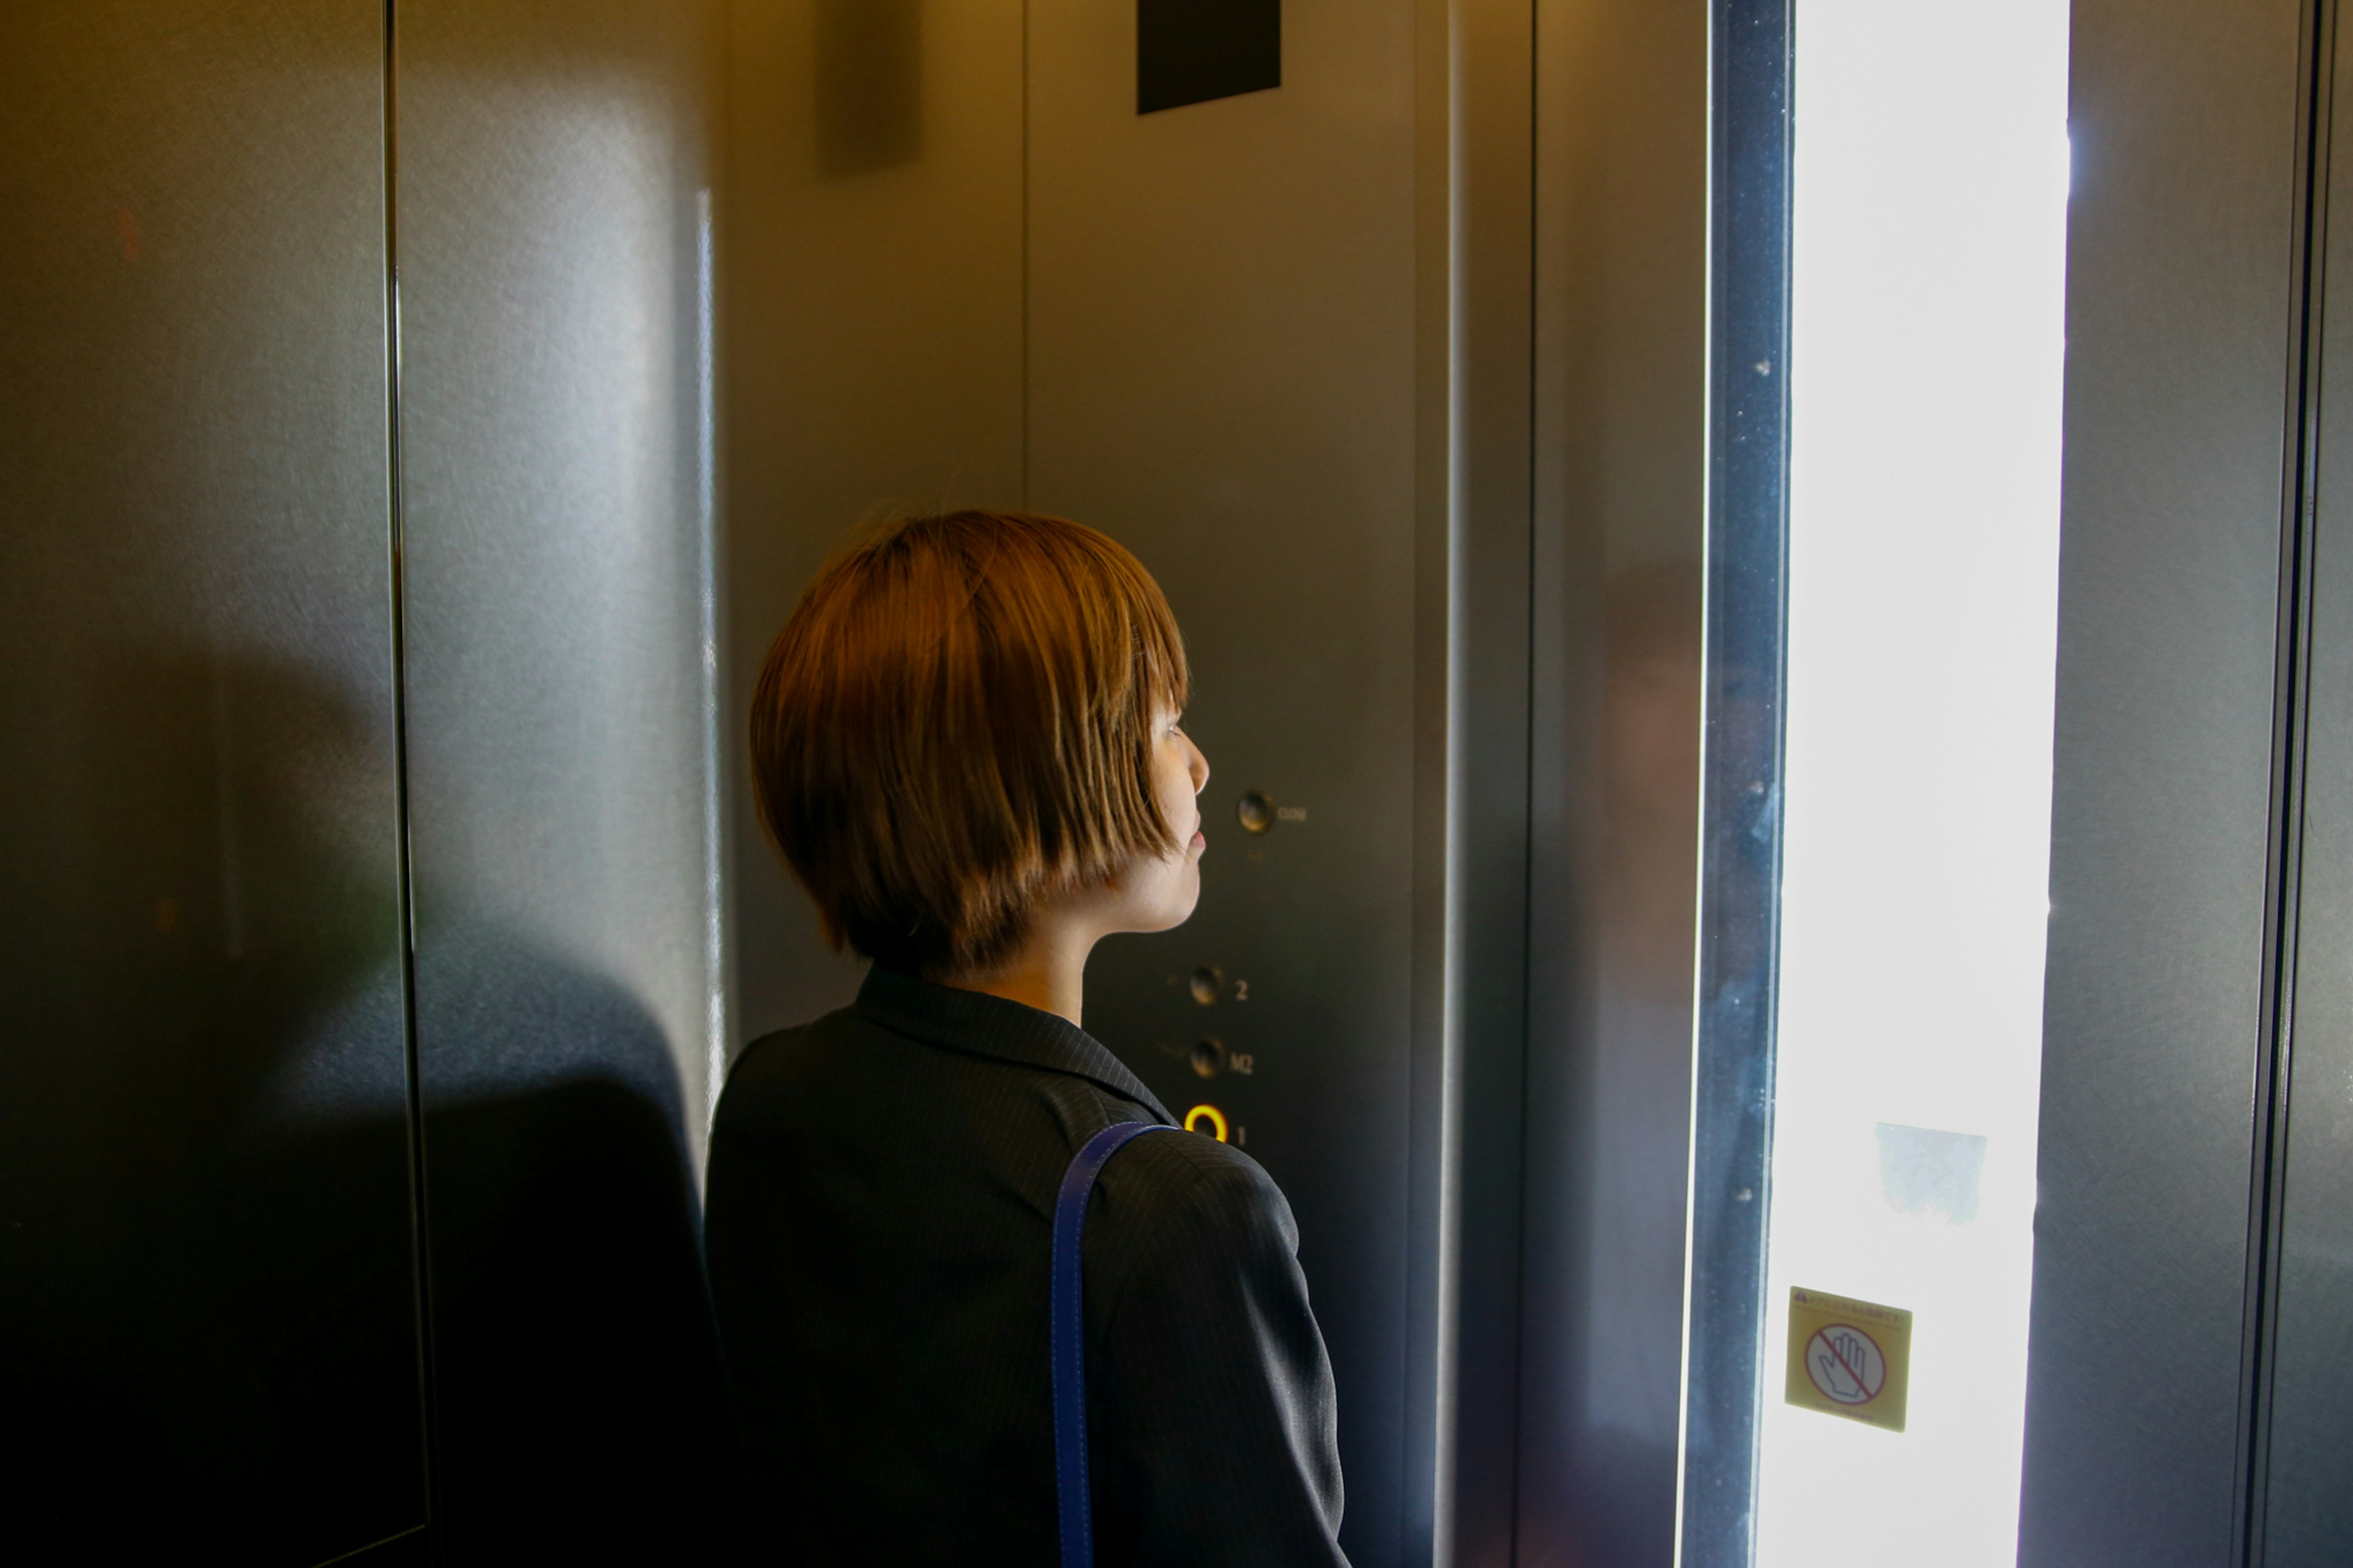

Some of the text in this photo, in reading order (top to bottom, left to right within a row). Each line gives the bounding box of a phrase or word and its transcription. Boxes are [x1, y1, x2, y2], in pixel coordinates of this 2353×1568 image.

[1236, 980, 1248, 1001] 2
[1230, 1051, 1254, 1075] M2
[1238, 1126, 1246, 1146] 1
